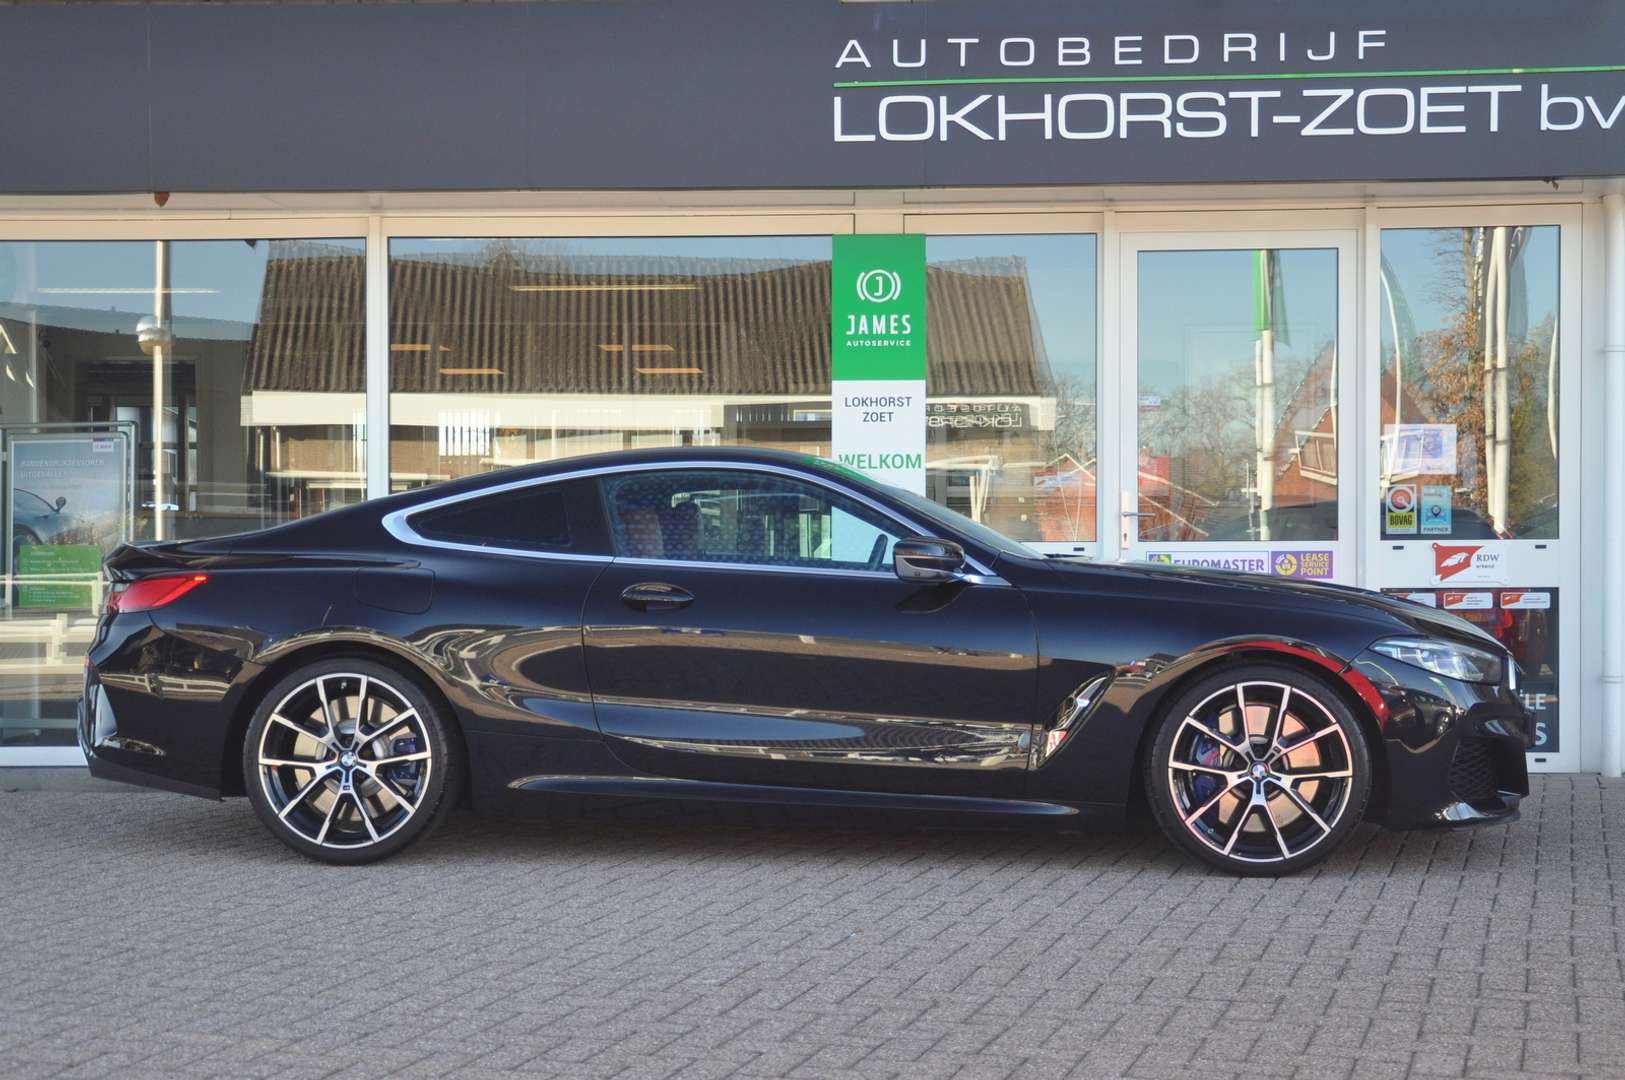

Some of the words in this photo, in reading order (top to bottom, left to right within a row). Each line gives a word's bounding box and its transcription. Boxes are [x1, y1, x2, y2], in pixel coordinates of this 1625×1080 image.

[835, 30, 1387, 68] AUTOBEDRIJF
[833, 84, 1522, 142] LOKHORST-ZOET
[1540, 83, 1625, 131] bv
[845, 314, 912, 335] JAMES
[846, 339, 912, 347] AUTOSERVICE
[844, 396, 913, 408] LOKHORST
[862, 411, 895, 423] ZOET
[838, 453, 923, 470] WELKOM
[1390, 514, 1413, 526] BOVAG
[1300, 553, 1329, 562] LEASE
[1476, 553, 1500, 562] RDW
[1300, 567, 1328, 576] POINT
